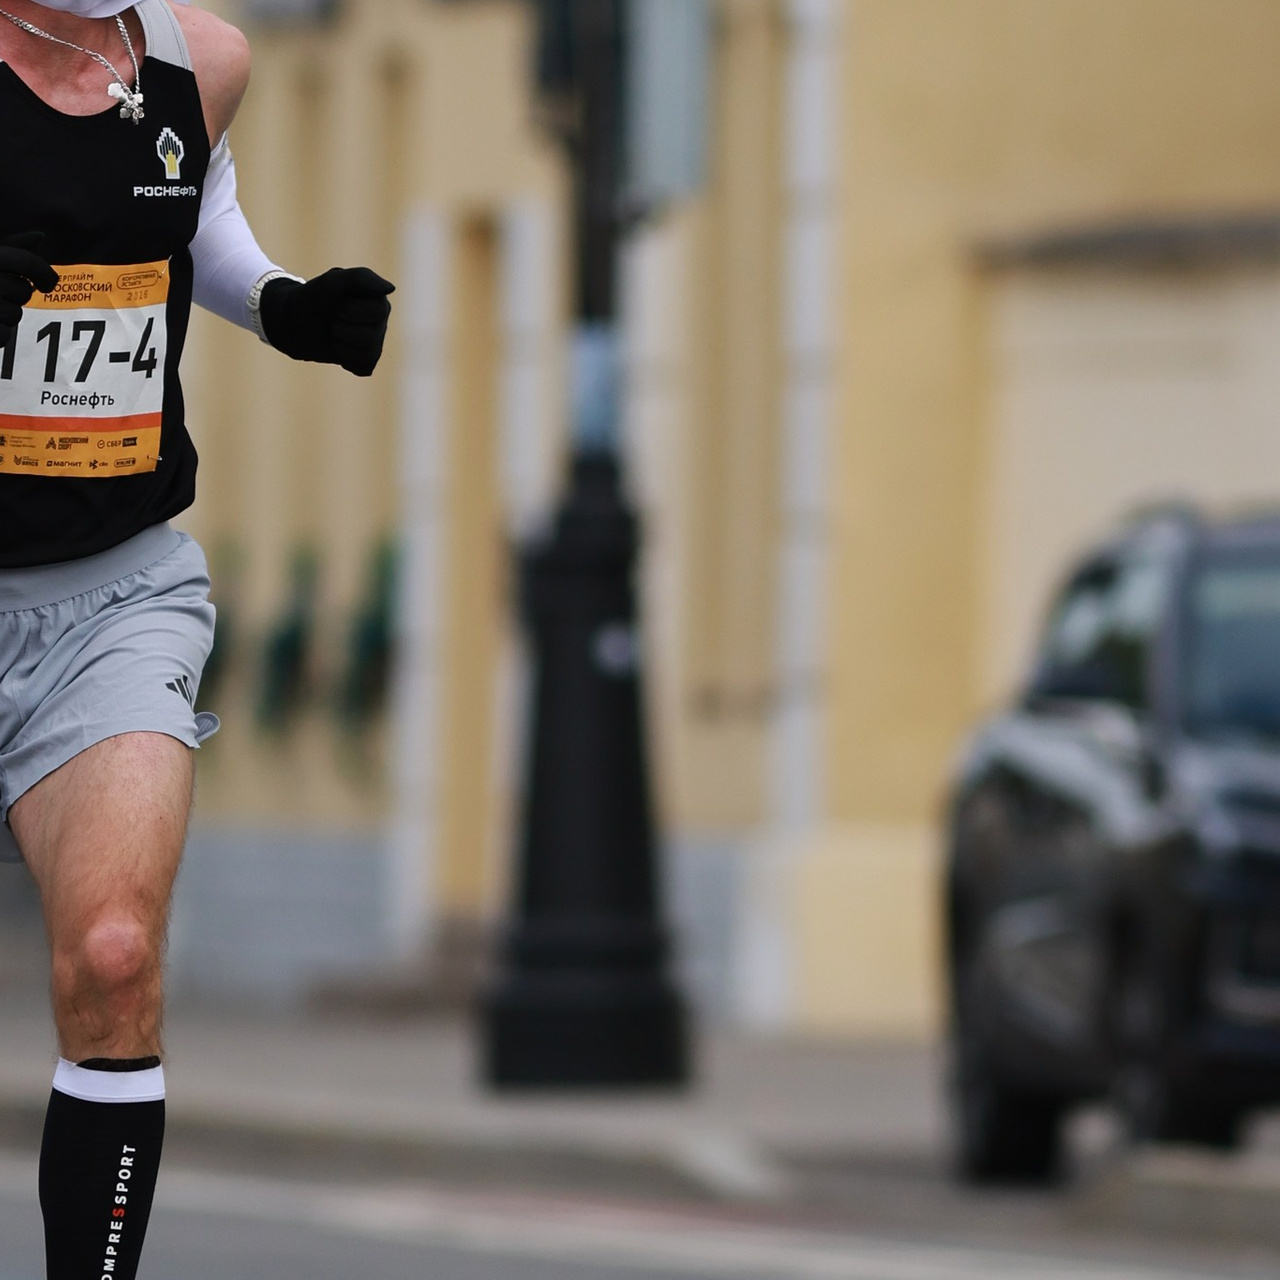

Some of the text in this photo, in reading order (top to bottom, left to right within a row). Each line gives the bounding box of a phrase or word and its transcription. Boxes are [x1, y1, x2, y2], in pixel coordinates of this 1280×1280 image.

[133, 185, 197, 197] РОСНЕФТЬ
[58, 273, 94, 282] ЕРПРАЙМ
[54, 281, 112, 293] ОСКОВСКИЙ
[43, 293, 92, 303] МАРАФОН
[1, 317, 158, 383] 117-4
[40, 391, 115, 409] Роснефть
